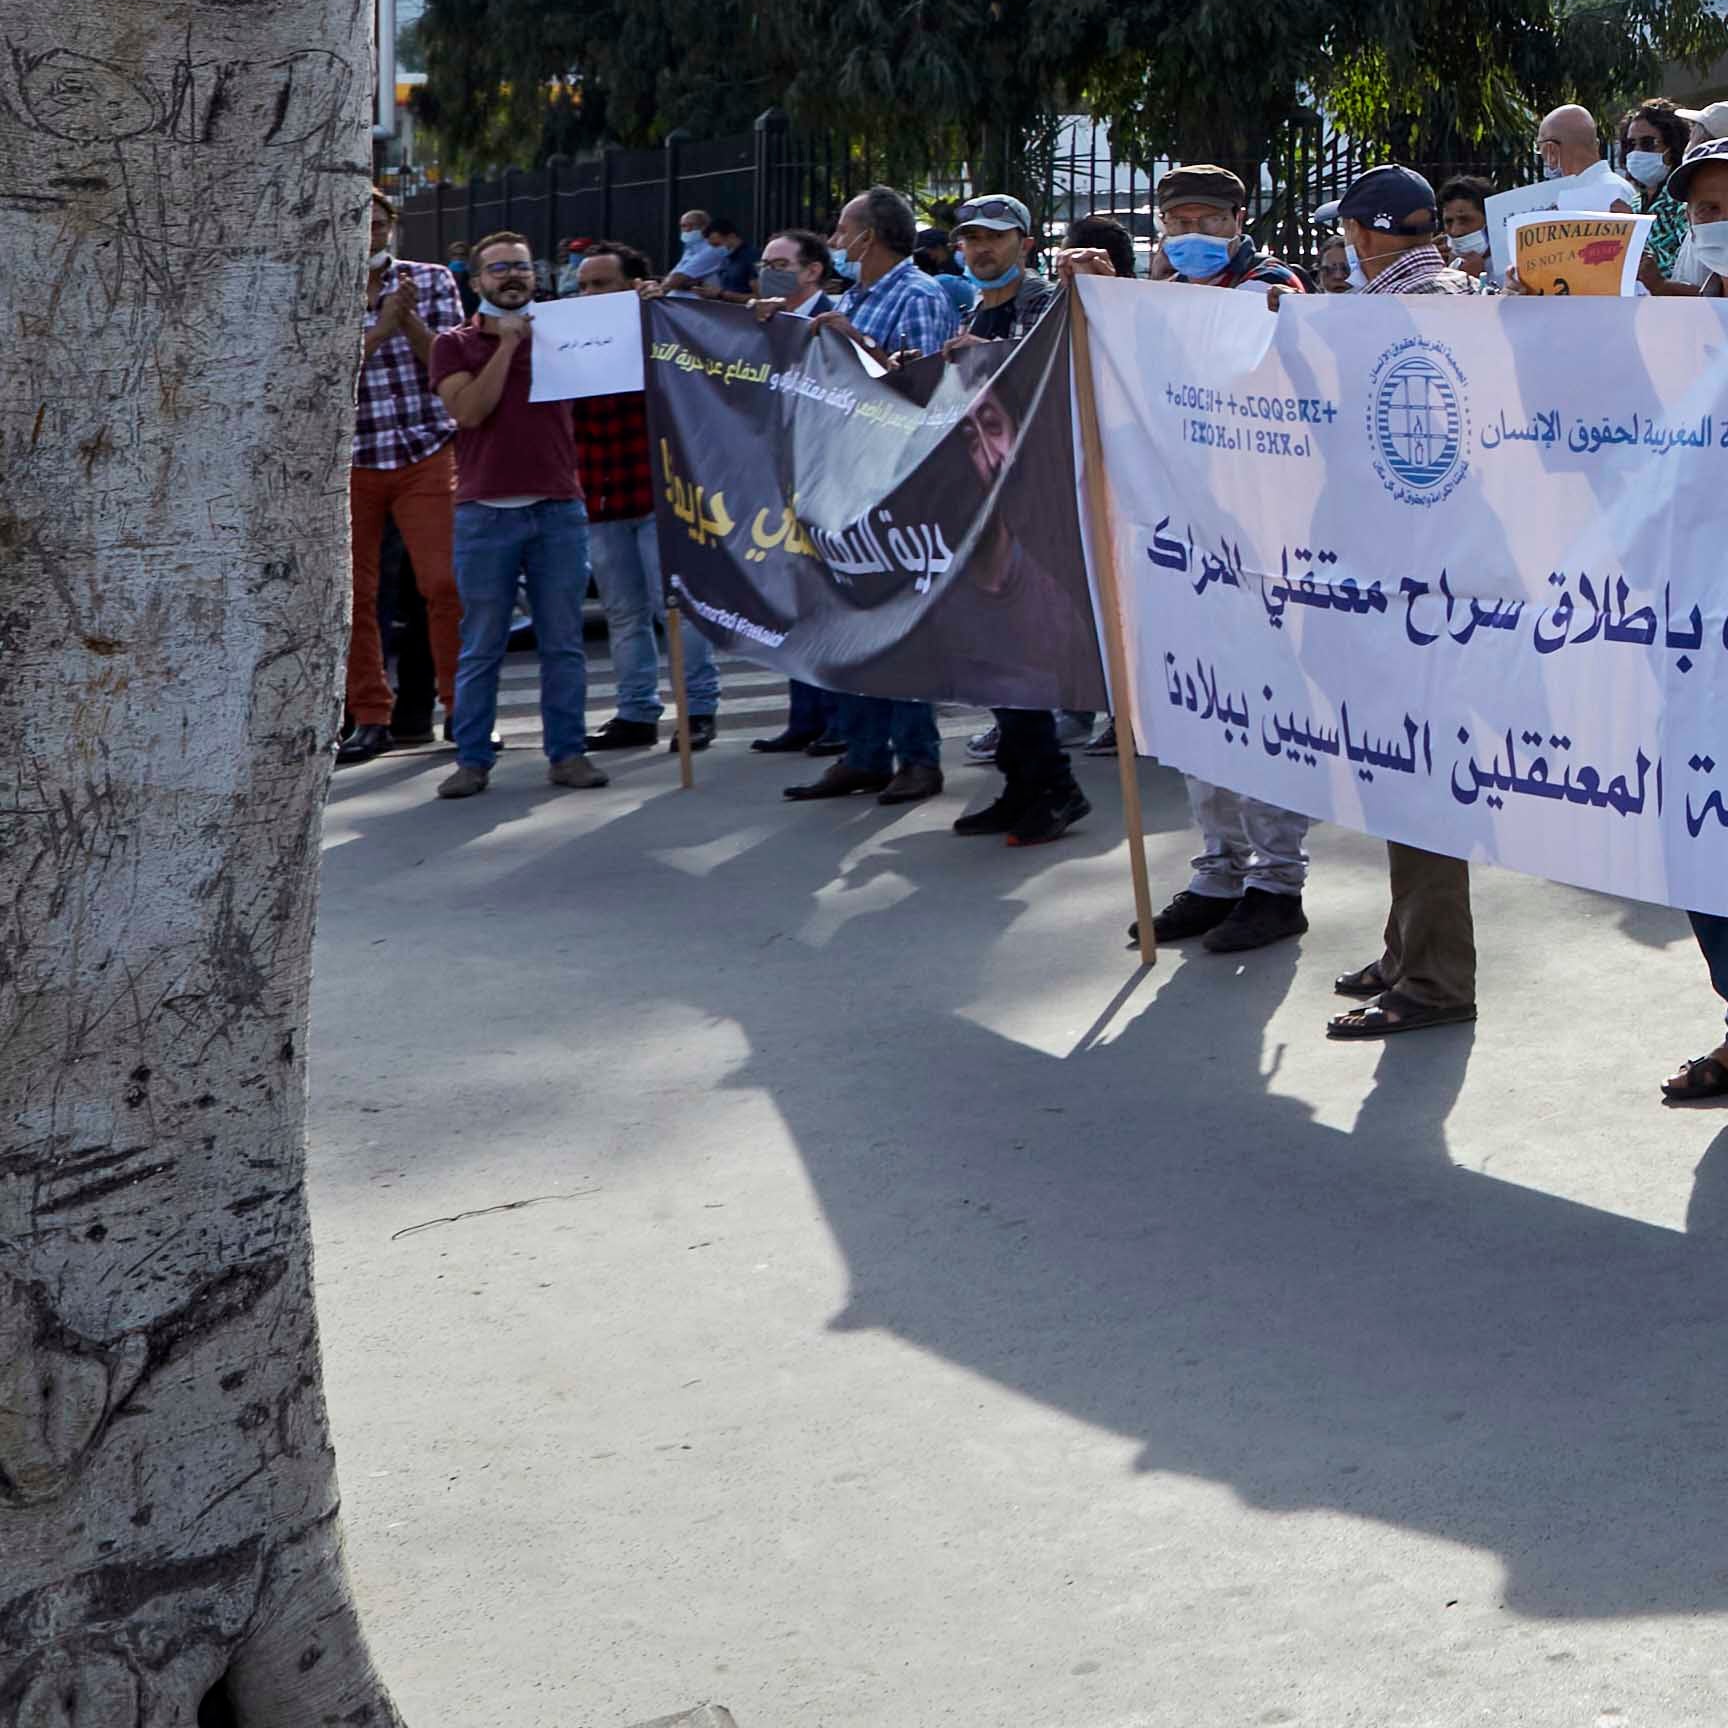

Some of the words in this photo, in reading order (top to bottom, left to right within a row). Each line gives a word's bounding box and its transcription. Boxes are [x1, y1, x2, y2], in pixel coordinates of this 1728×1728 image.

[1519, 223, 1629, 252] JOURNALISM
[1526, 258, 1537, 273] IS
[1539, 250, 1565, 267] NOT
[1567, 249, 1577, 261] A
[674, 348, 705, 372] حرية
[723, 357, 772, 385] الدفاع
[1479, 407, 1562, 451] الإنسان
[1567, 411, 1639, 455] لحقوق
[1642, 414, 1713, 457] المغربية
[1146, 514, 1243, 596] الحراك
[1260, 543, 1389, 630] معتقلي
[1399, 567, 1526, 647] سراح
[1532, 570, 1704, 675] باطلاق
[1163, 650, 1250, 748] ببلادنا
[1261, 683, 1433, 784] السياسيين
[1450, 725, 1665, 818] المعتقلين
